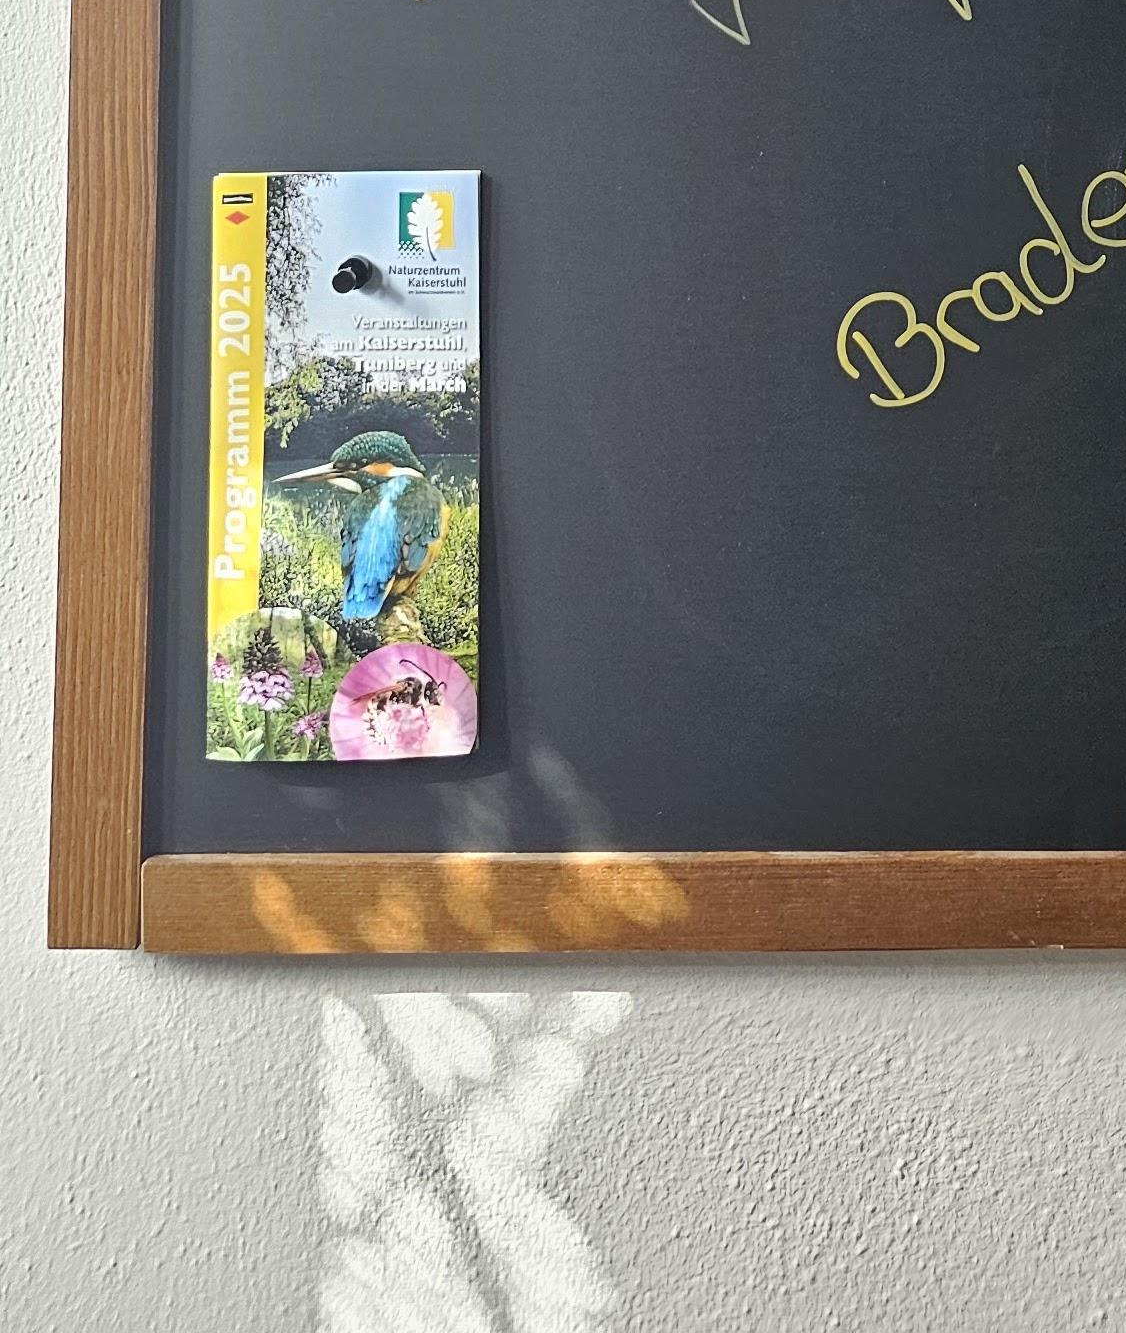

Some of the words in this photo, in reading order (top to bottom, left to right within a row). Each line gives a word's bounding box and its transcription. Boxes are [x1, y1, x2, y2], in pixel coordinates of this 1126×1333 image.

[389, 265, 460, 275] Naturzentrum
[408, 277, 466, 287] Kaiserstuhl
[218, 262, 252, 358] 2025
[352, 315, 467, 333] Veranstaltungen
[333, 339, 354, 351] am
[352, 356, 437, 375] Tuniberg
[441, 358, 466, 371] und
[408, 374, 467, 393] March
[213, 370, 256, 582] Programm
